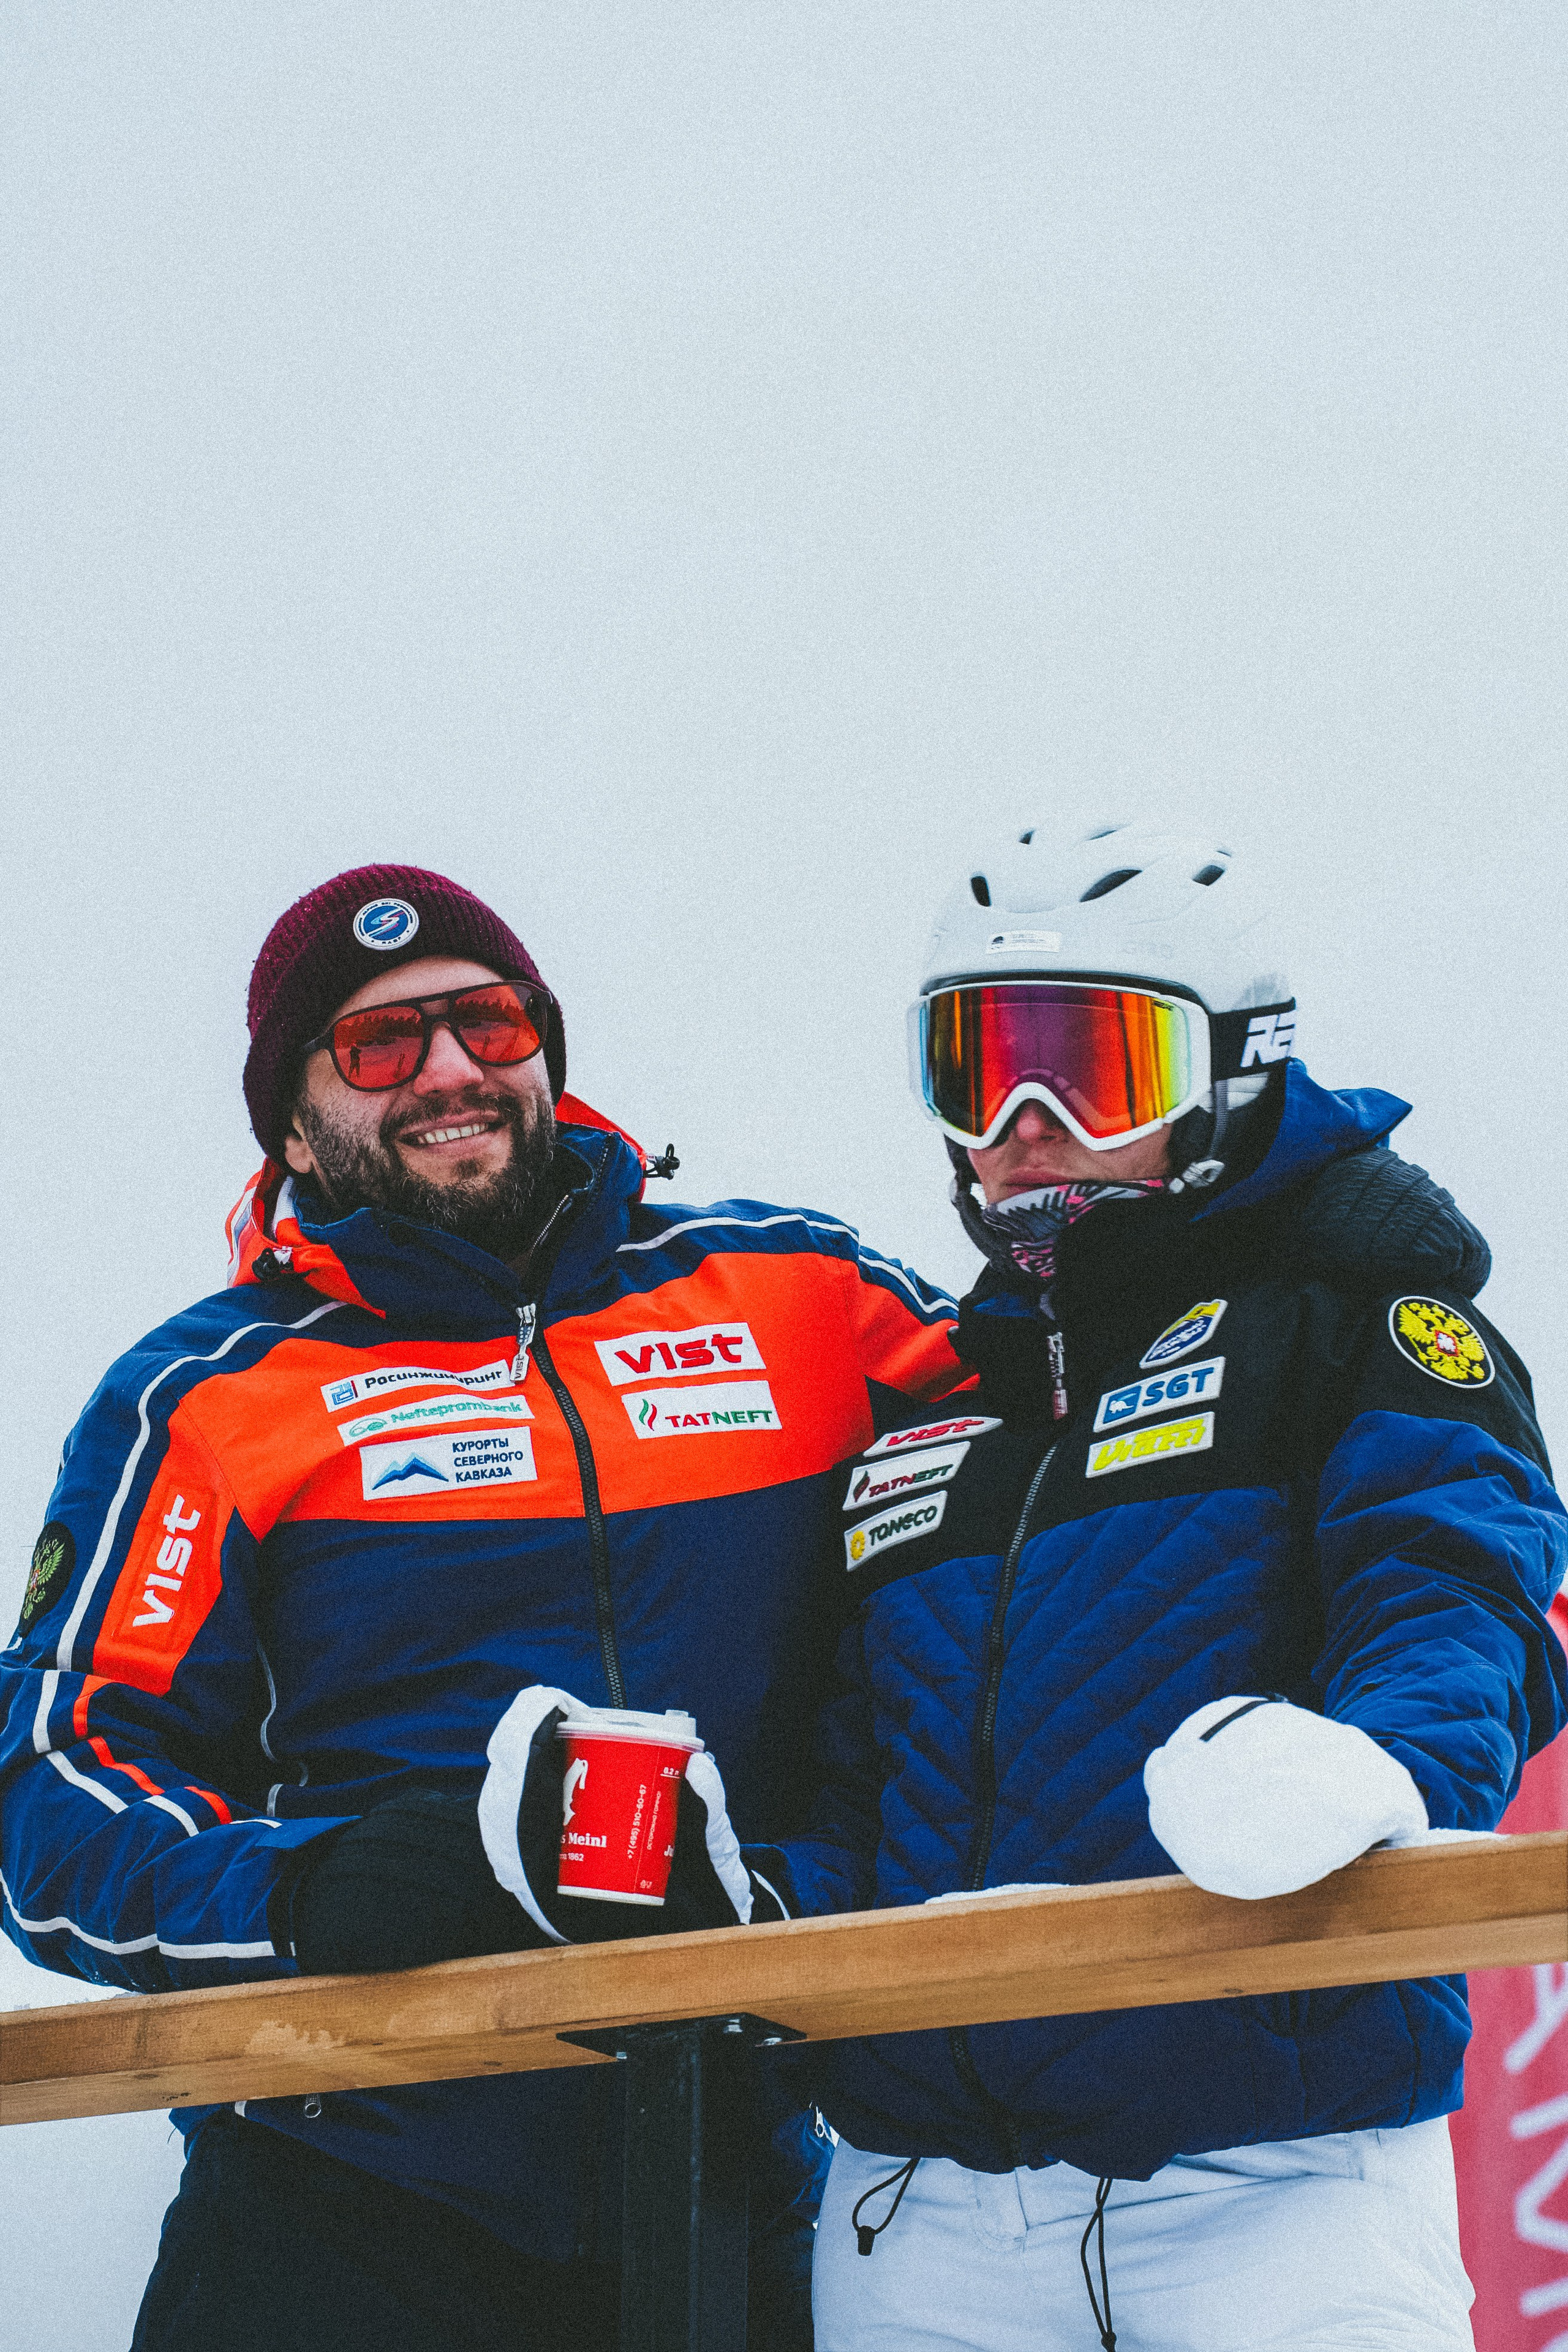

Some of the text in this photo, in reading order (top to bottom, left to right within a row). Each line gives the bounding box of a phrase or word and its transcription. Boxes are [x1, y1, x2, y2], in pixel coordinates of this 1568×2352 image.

[1142, 1366, 1215, 1406] SGT
[665, 1409, 773, 1428] TATNEFT
[452, 1437, 509, 1453] КУРОРТЫ
[454, 1450, 524, 1467] СЕВЕРНОГО
[456, 1466, 512, 1483] КАВКАЗА
[869, 1464, 954, 1498] TATNEFT
[568, 1832, 607, 1848] Meinl
[568, 1852, 584, 1862] 1862
